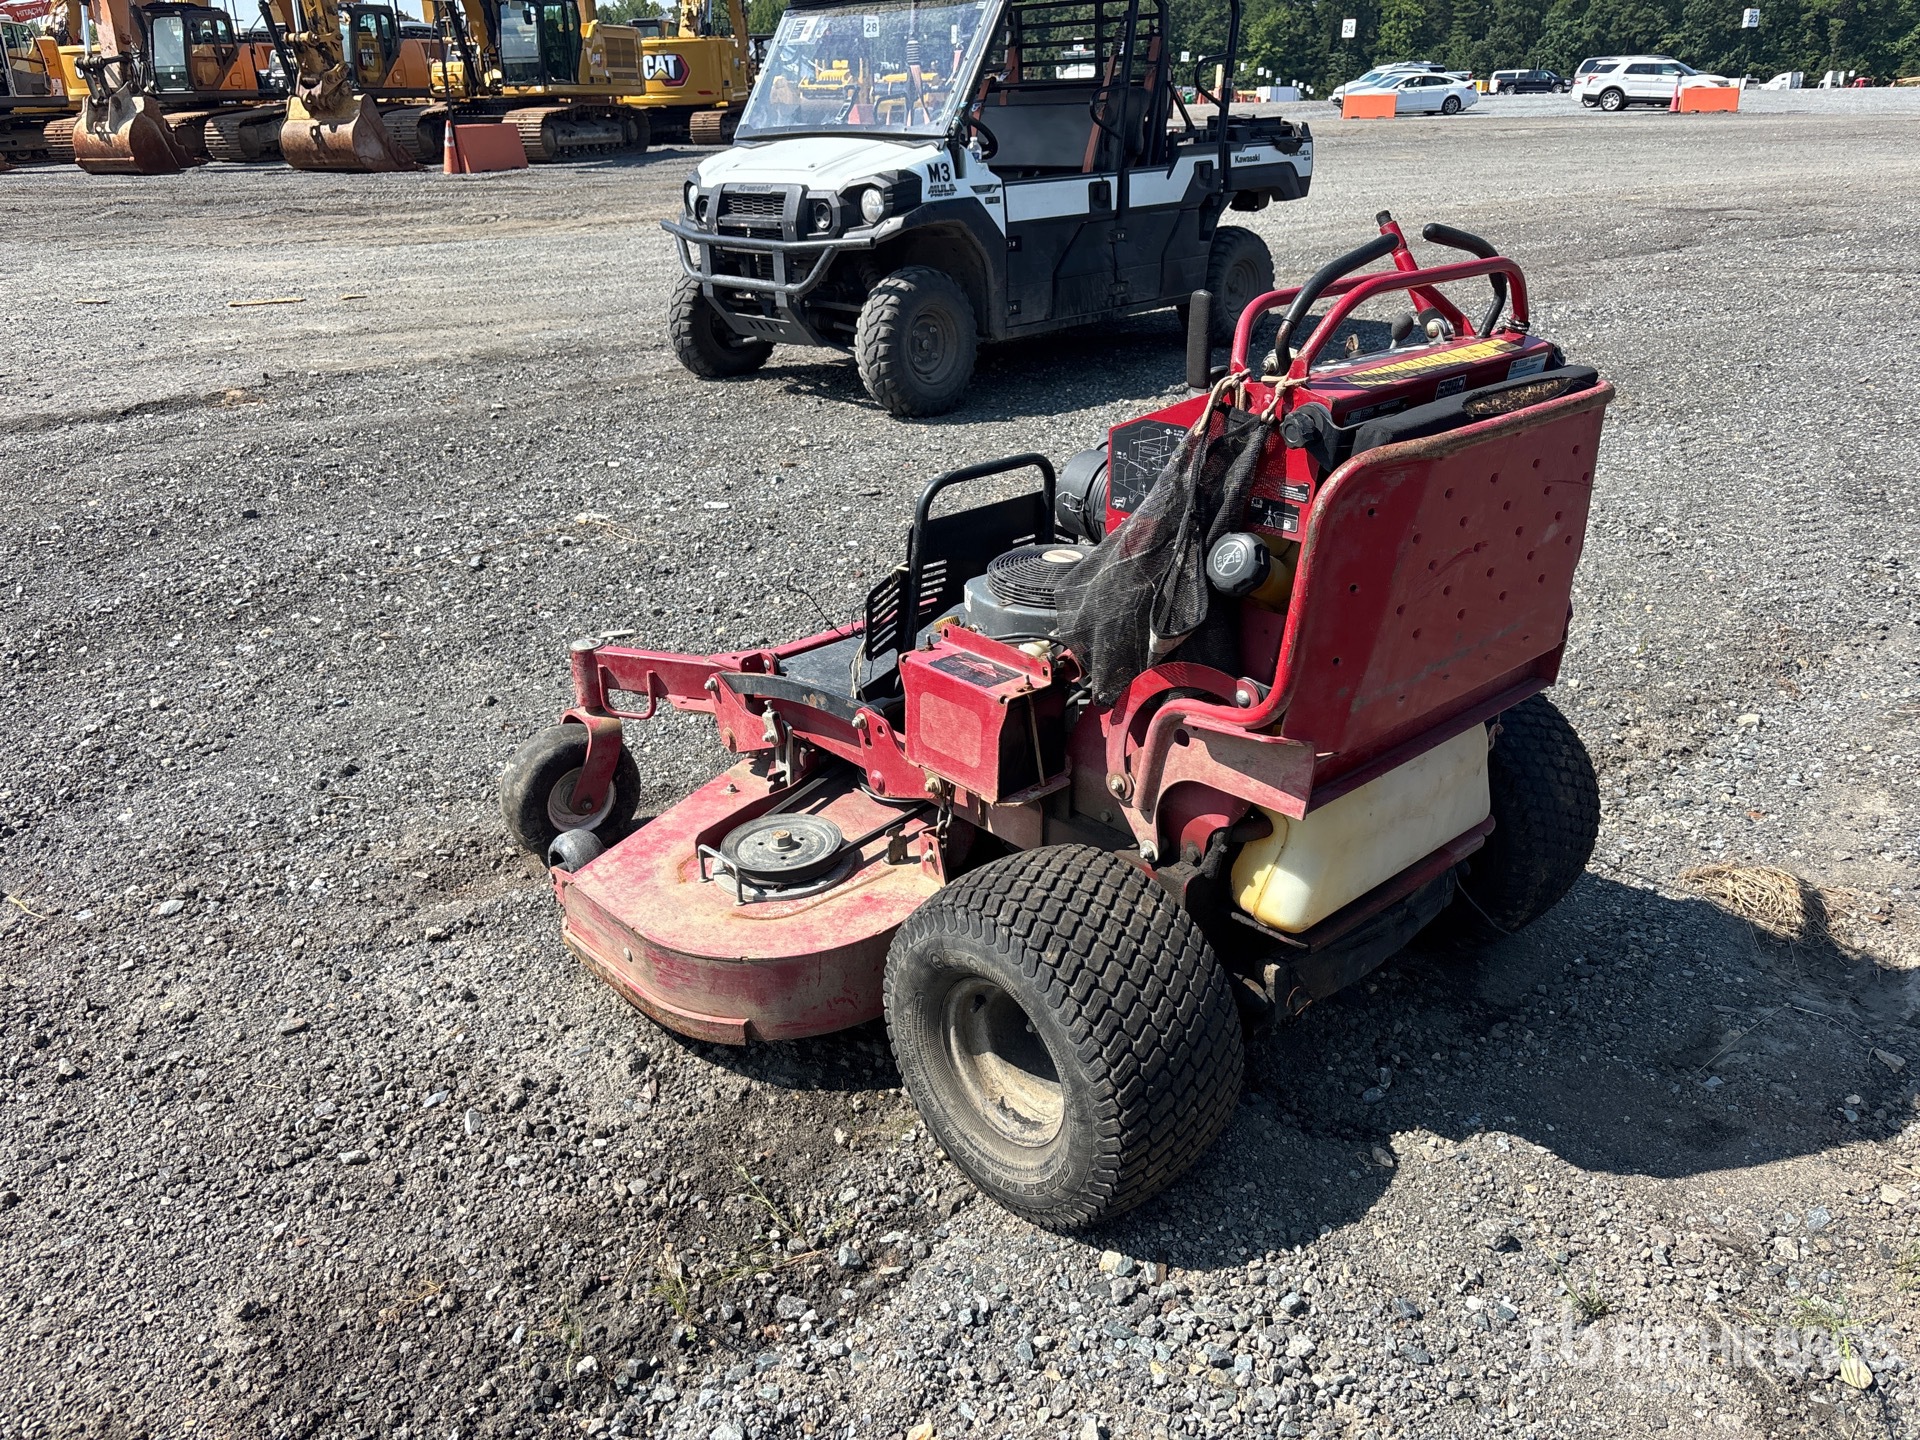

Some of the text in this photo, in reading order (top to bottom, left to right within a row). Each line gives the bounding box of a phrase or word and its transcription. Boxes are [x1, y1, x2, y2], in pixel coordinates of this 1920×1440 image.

[16, 7, 44, 17] HITACHI
[1749, 14, 1758, 23] 23
[865, 22, 878, 33] 28
[1344, 25, 1354, 34] 24
[642, 54, 677, 80] CAT
[1234, 153, 1261, 164] Kawasaki
[926, 162, 951, 183] M3
